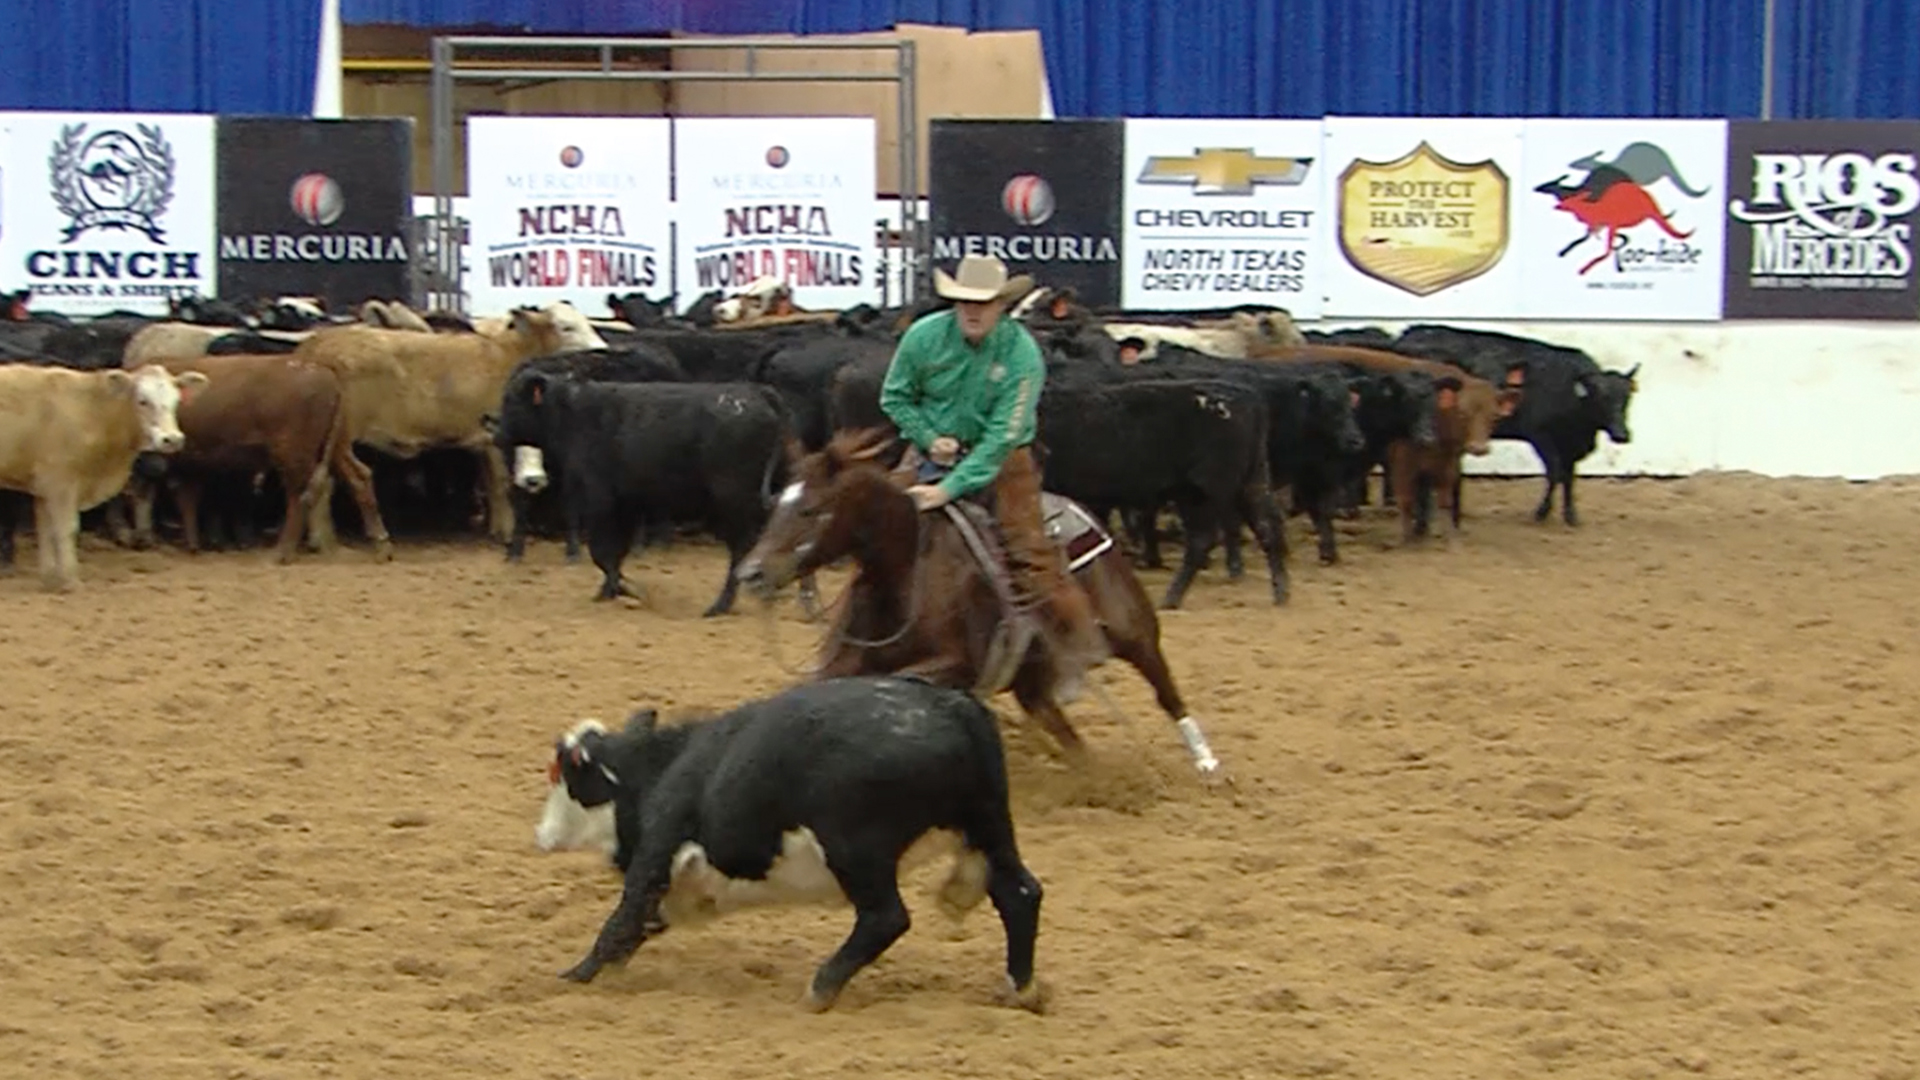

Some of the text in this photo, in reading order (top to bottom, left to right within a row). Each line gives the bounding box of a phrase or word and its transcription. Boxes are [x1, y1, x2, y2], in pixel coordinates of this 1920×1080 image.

[506, 173, 637, 189] MERCURIA
[712, 173, 843, 189] MERCURIA
[1369, 181, 1476, 198] PROTECT
[1729, 153, 1920, 231] RIOS
[1408, 200, 1435, 209] THE
[518, 204, 625, 237] NCHA
[724, 204, 832, 238] NCHA
[1135, 209, 1315, 228] CHEVROLET
[1370, 211, 1475, 228] HARVEST
[221, 234, 408, 261] MERCURIA
[934, 235, 1118, 260] MERCURIA
[1751, 220, 1911, 276] MERCEDES
[26, 250, 201, 279] CINCH
[488, 249, 656, 287] WORLD FINALS
[695, 249, 863, 287] WORLD FINALS
[1143, 249, 1307, 271] NORTH TEXAS
[28, 284, 199, 297] JEANS & SHIRTS
[1142, 273, 1304, 292] CHEVY DEALERS
